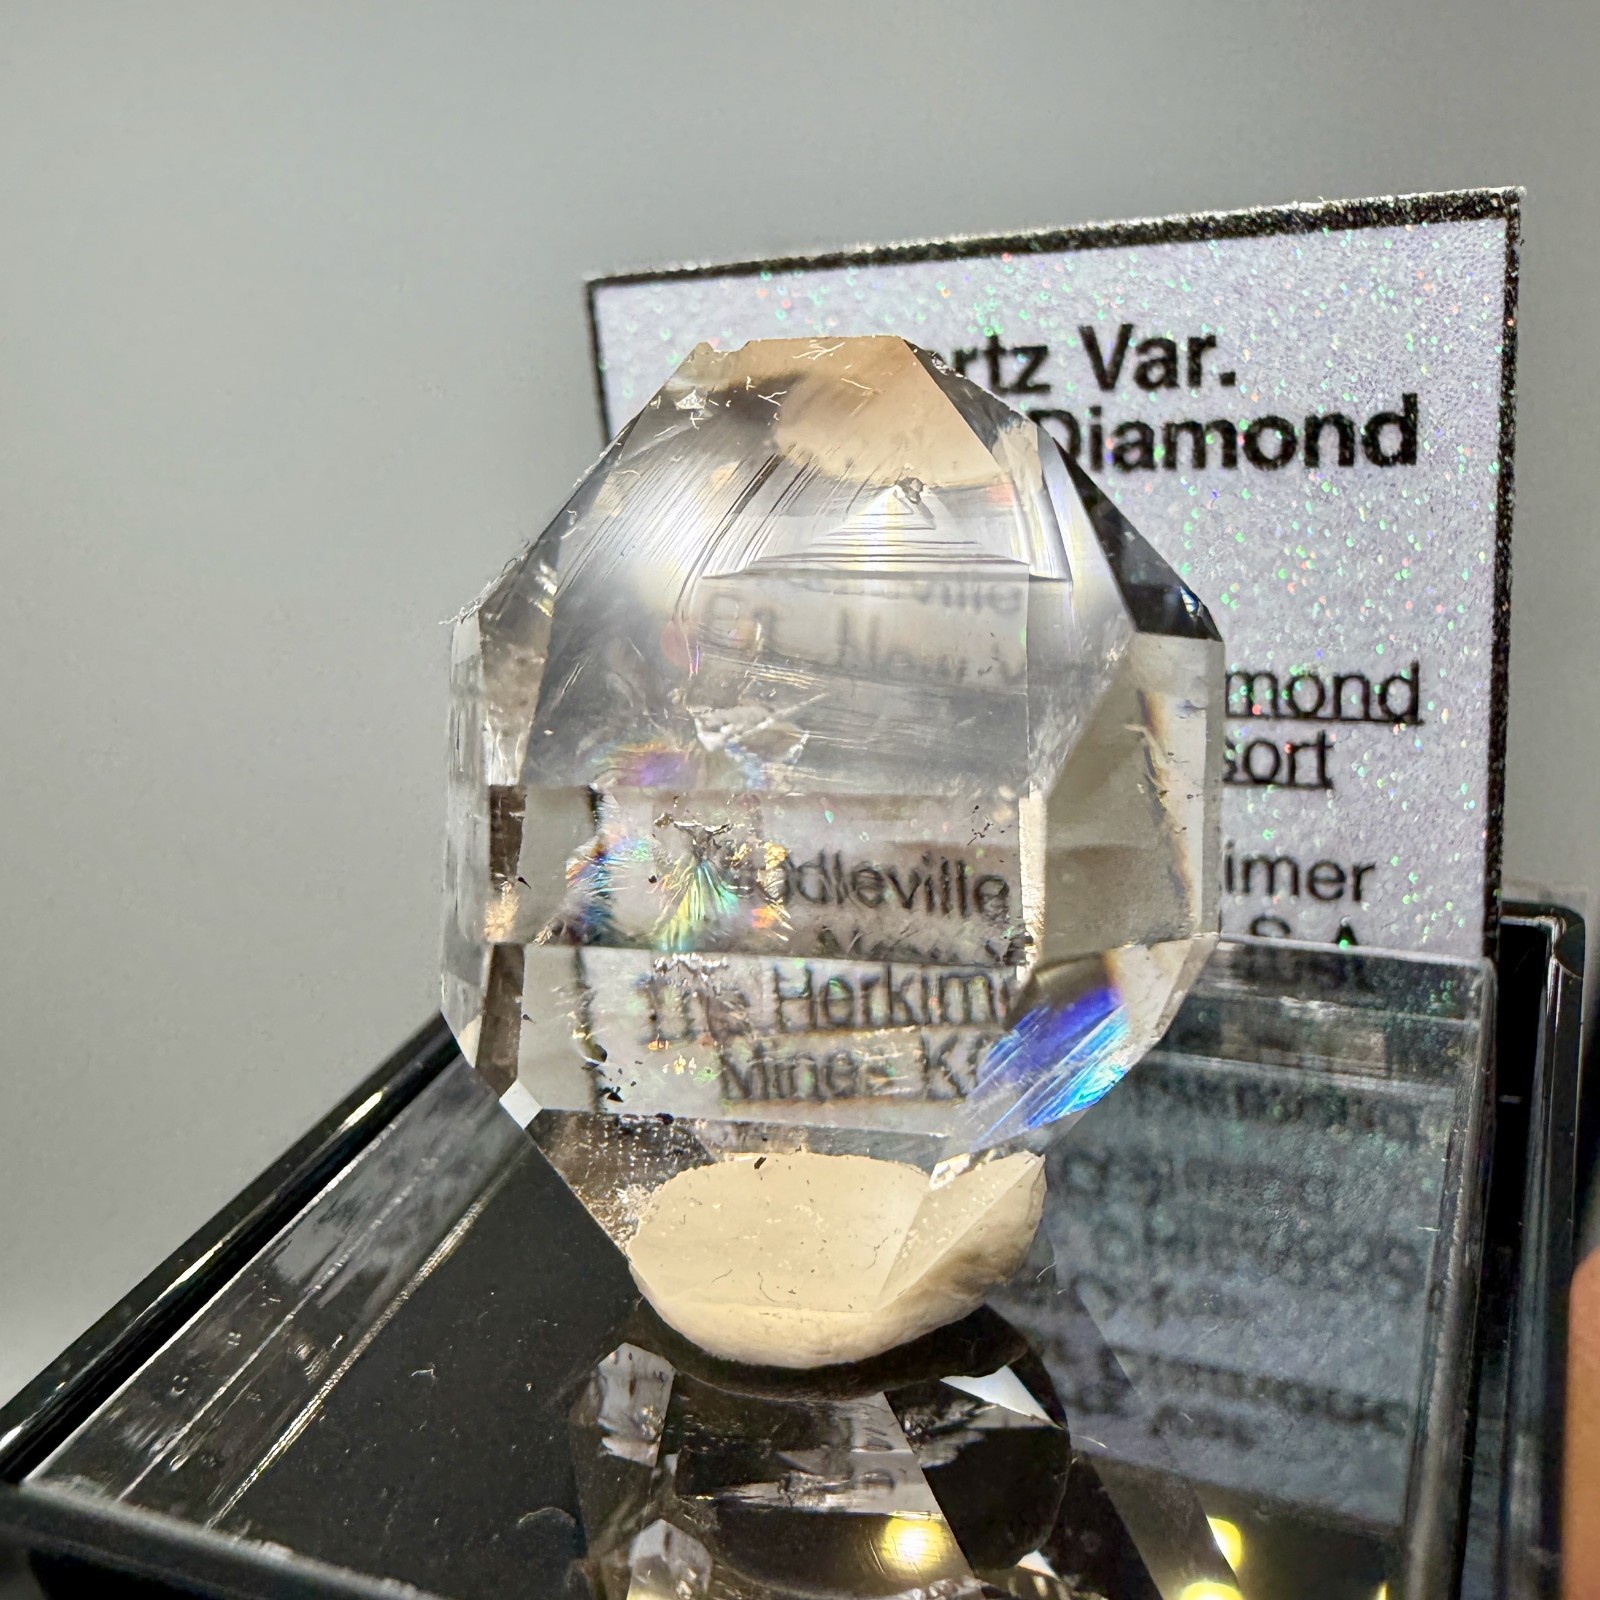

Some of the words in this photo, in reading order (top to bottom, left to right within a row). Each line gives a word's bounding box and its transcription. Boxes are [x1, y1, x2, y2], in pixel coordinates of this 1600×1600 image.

[928, 330, 1051, 394] rtz
[1078, 323, 1237, 391] Var.
[1225, 660, 1420, 721] mond
[1224, 840, 1376, 901] imer
